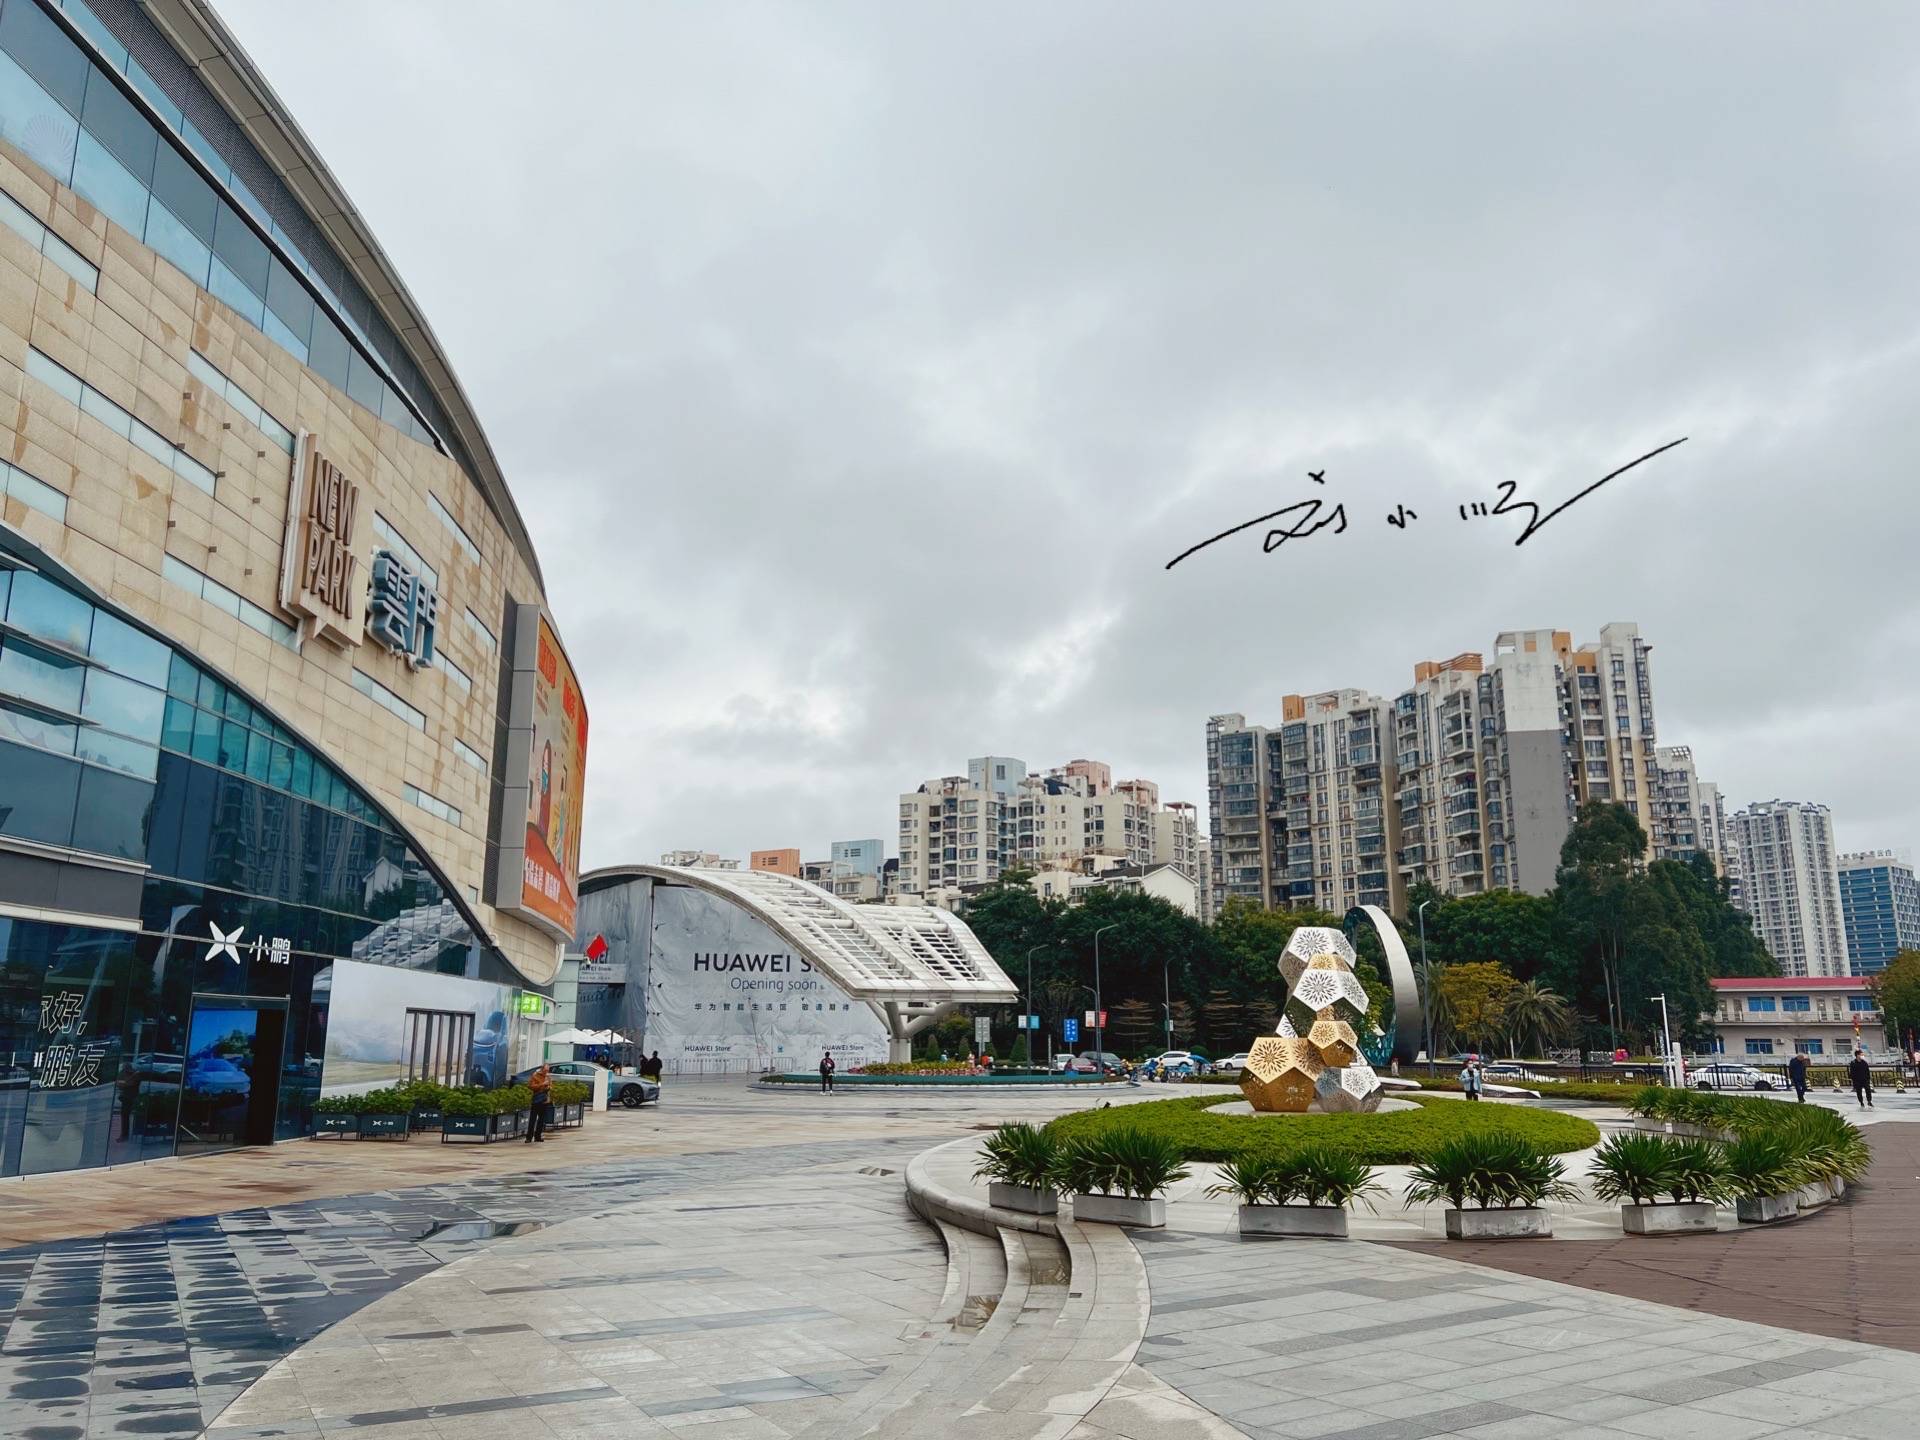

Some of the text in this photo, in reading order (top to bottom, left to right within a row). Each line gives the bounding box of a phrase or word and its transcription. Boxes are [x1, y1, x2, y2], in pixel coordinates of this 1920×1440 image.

[309, 451, 360, 546] NEW
[302, 521, 358, 619] PARK
[248, 934, 291, 965] 小鹏
[693, 952, 791, 973] HUAWEI
[730, 977, 817, 993] Opening soon
[40, 1044, 106, 1088] 鹏友
